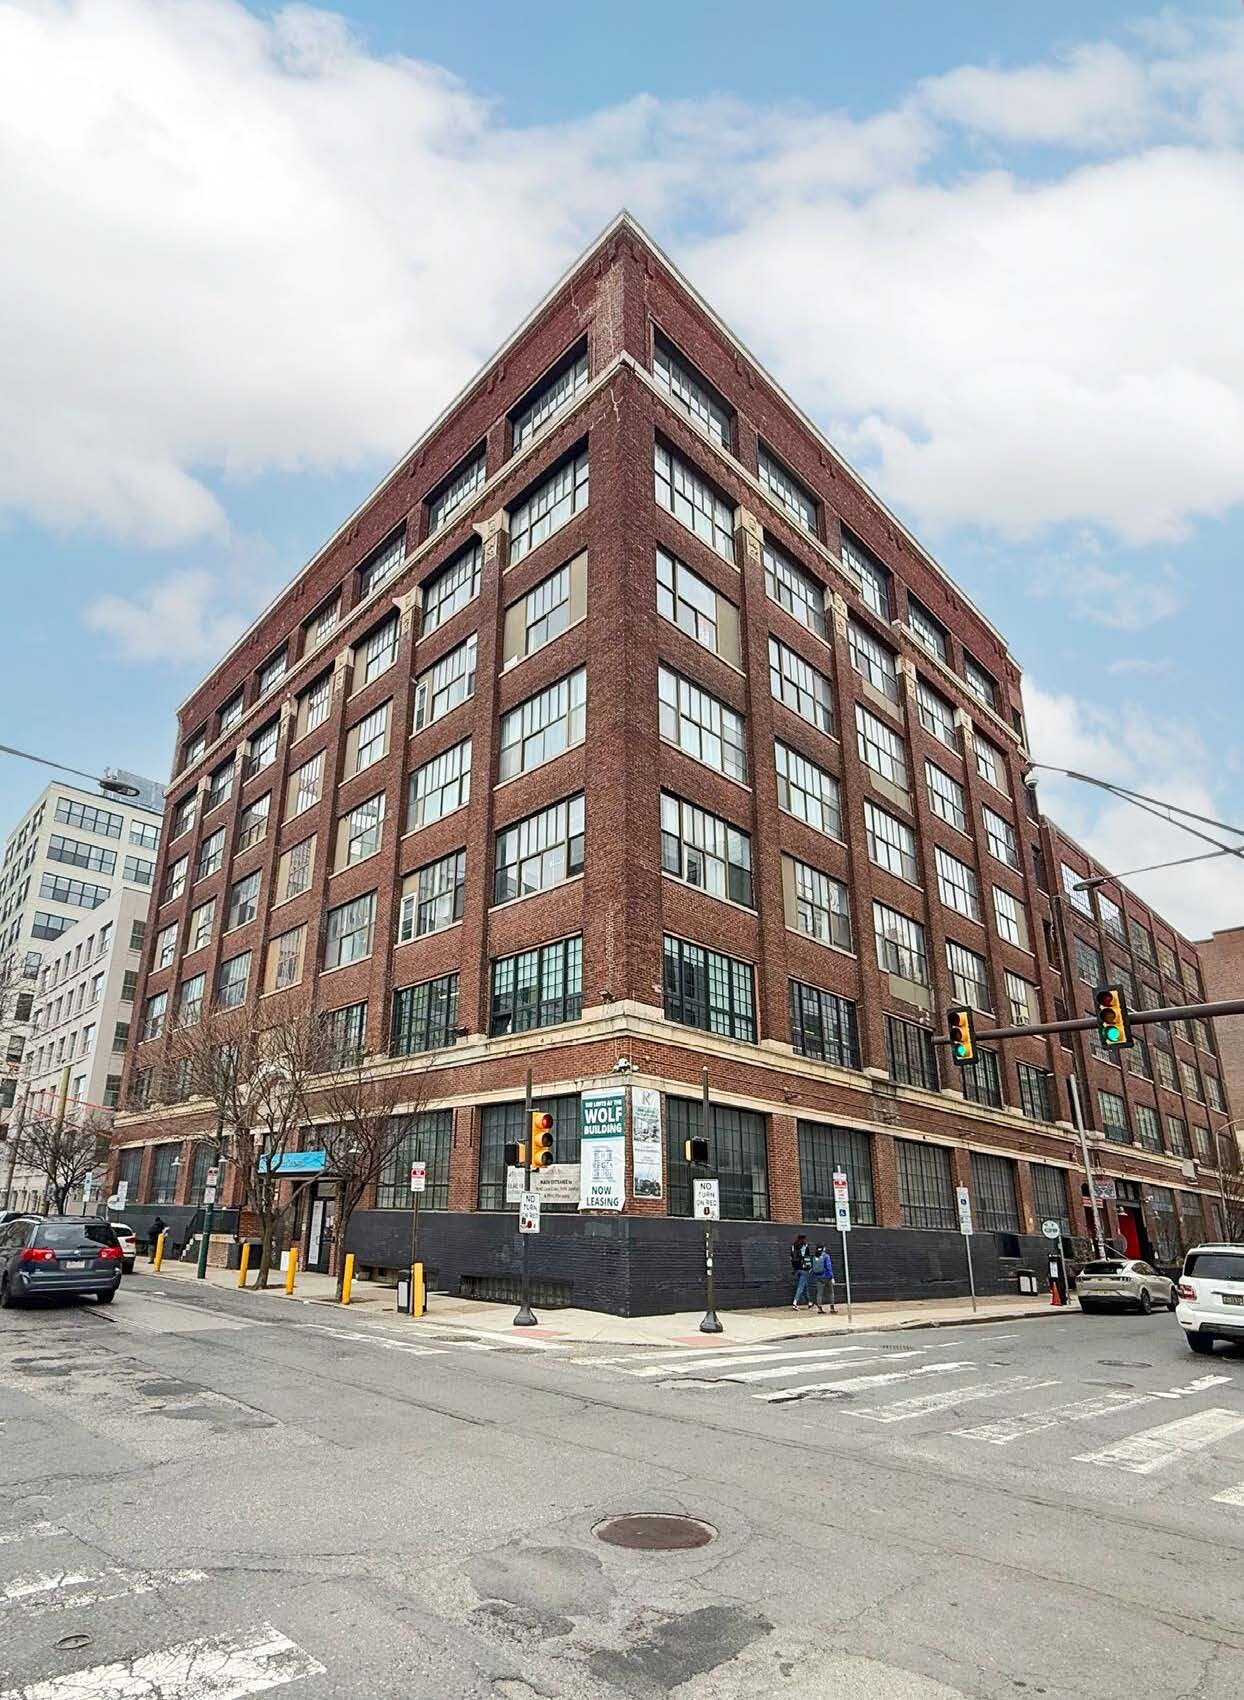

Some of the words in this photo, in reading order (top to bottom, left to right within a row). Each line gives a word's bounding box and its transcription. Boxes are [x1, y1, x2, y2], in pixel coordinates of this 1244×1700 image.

[584, 1106, 622, 1124] WOLF
[584, 1123, 622, 1135] BUILDING
[591, 1185, 612, 1195] NOW
[700, 1182, 712, 1190] NO
[525, 1195, 536, 1203] NO
[586, 1196, 620, 1207] LEASING
